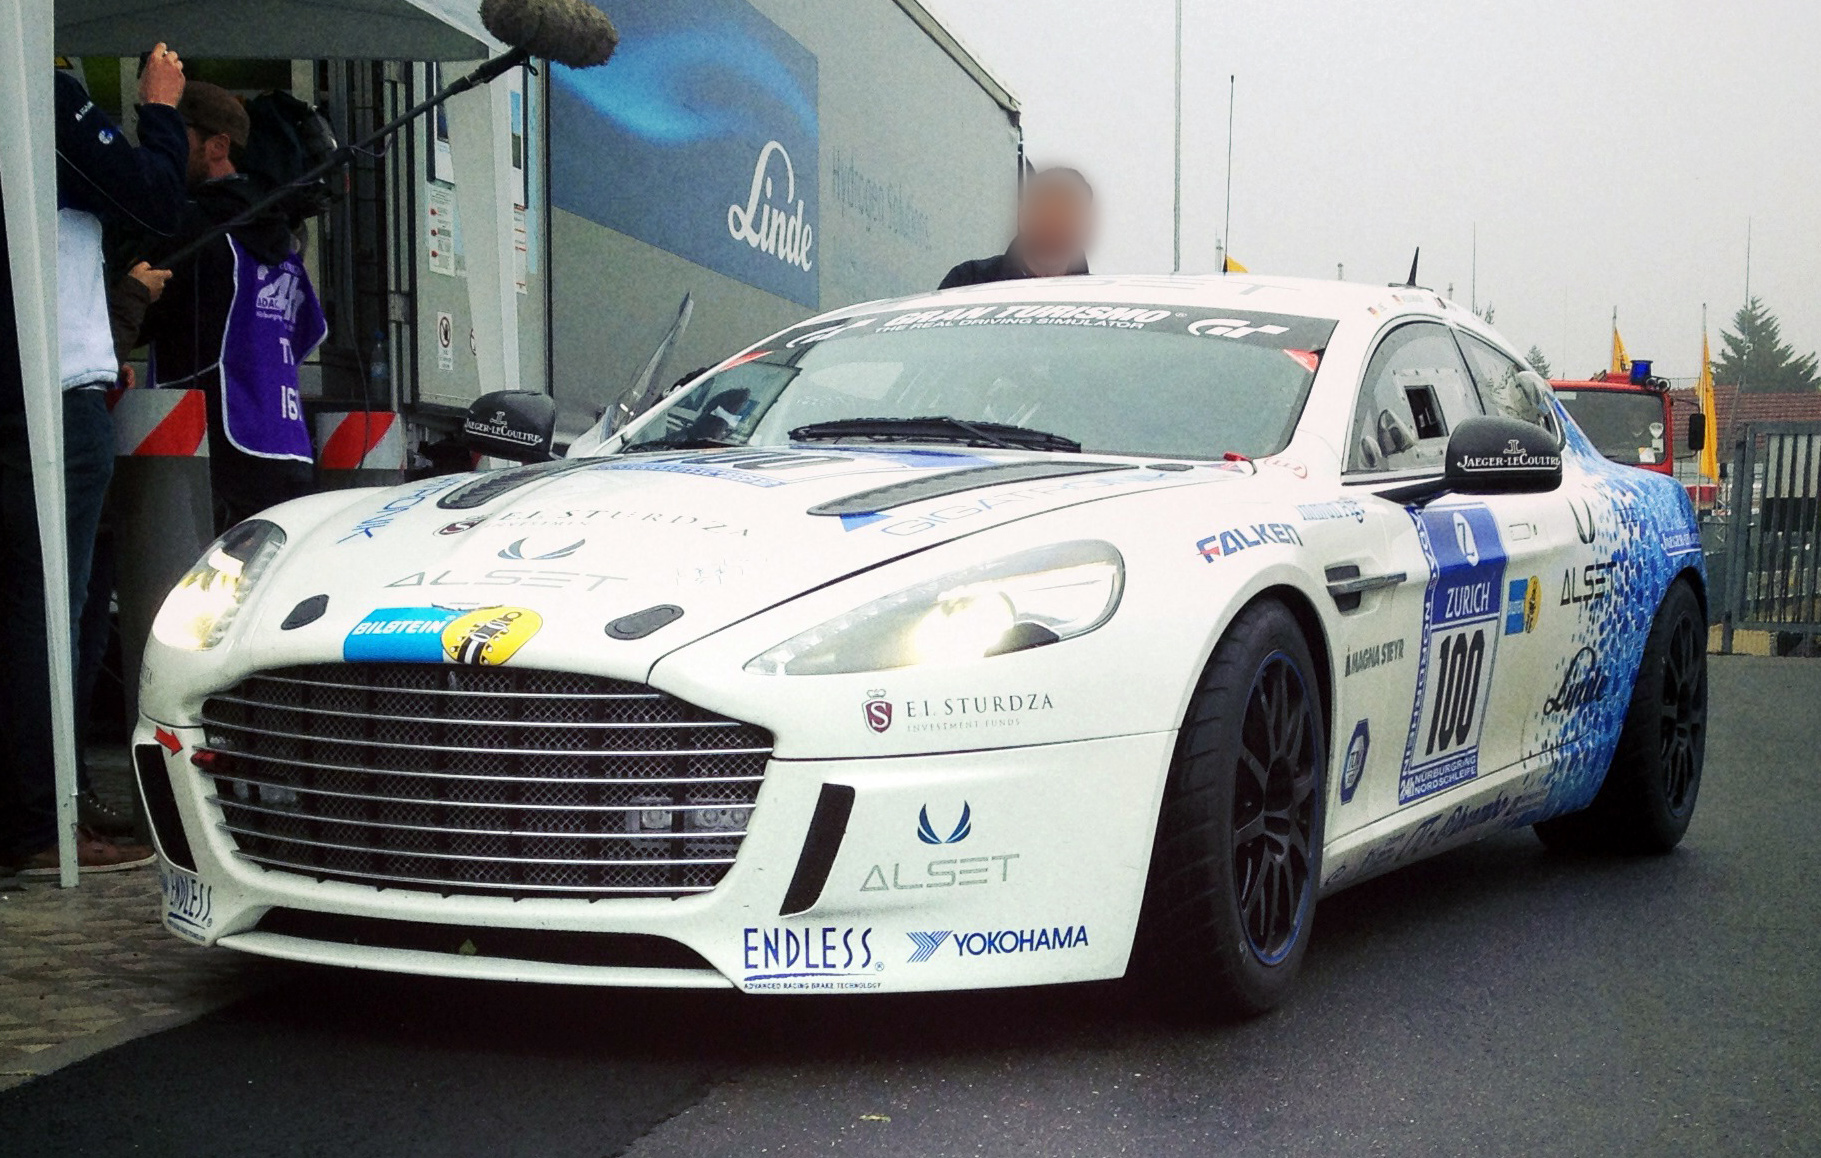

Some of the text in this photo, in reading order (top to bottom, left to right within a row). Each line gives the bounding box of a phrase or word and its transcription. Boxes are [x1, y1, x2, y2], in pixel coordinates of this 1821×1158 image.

[728, 140, 813, 272] Linde
[884, 304, 1171, 327] GRAN TURISMO
[911, 320, 954, 330] REAL
[958, 317, 1033, 327] DRIVING
[1036, 318, 1144, 329] SIMULATOR
[1196, 523, 1304, 563] FALKEN
[382, 569, 628, 592] ALSET
[1560, 560, 1617, 606] ALSET
[1445, 581, 1491, 619] ZURICH
[352, 620, 448, 636] BILSTEIN
[944, 693, 1054, 716] STURDZA
[1425, 629, 1485, 757] 100
[907, 717, 1021, 732] INVESTMENT FUNDS
[1414, 765, 1477, 795] NORDSCHLEIFE
[859, 853, 1020, 892] ALSET
[744, 927, 873, 969] ENDLESS
[953, 925, 1089, 956] YOKOHAMA
[744, 982, 782, 990] ADVANCED
[783, 982, 810, 990] RACING
[811, 982, 834, 990] BRAKE
